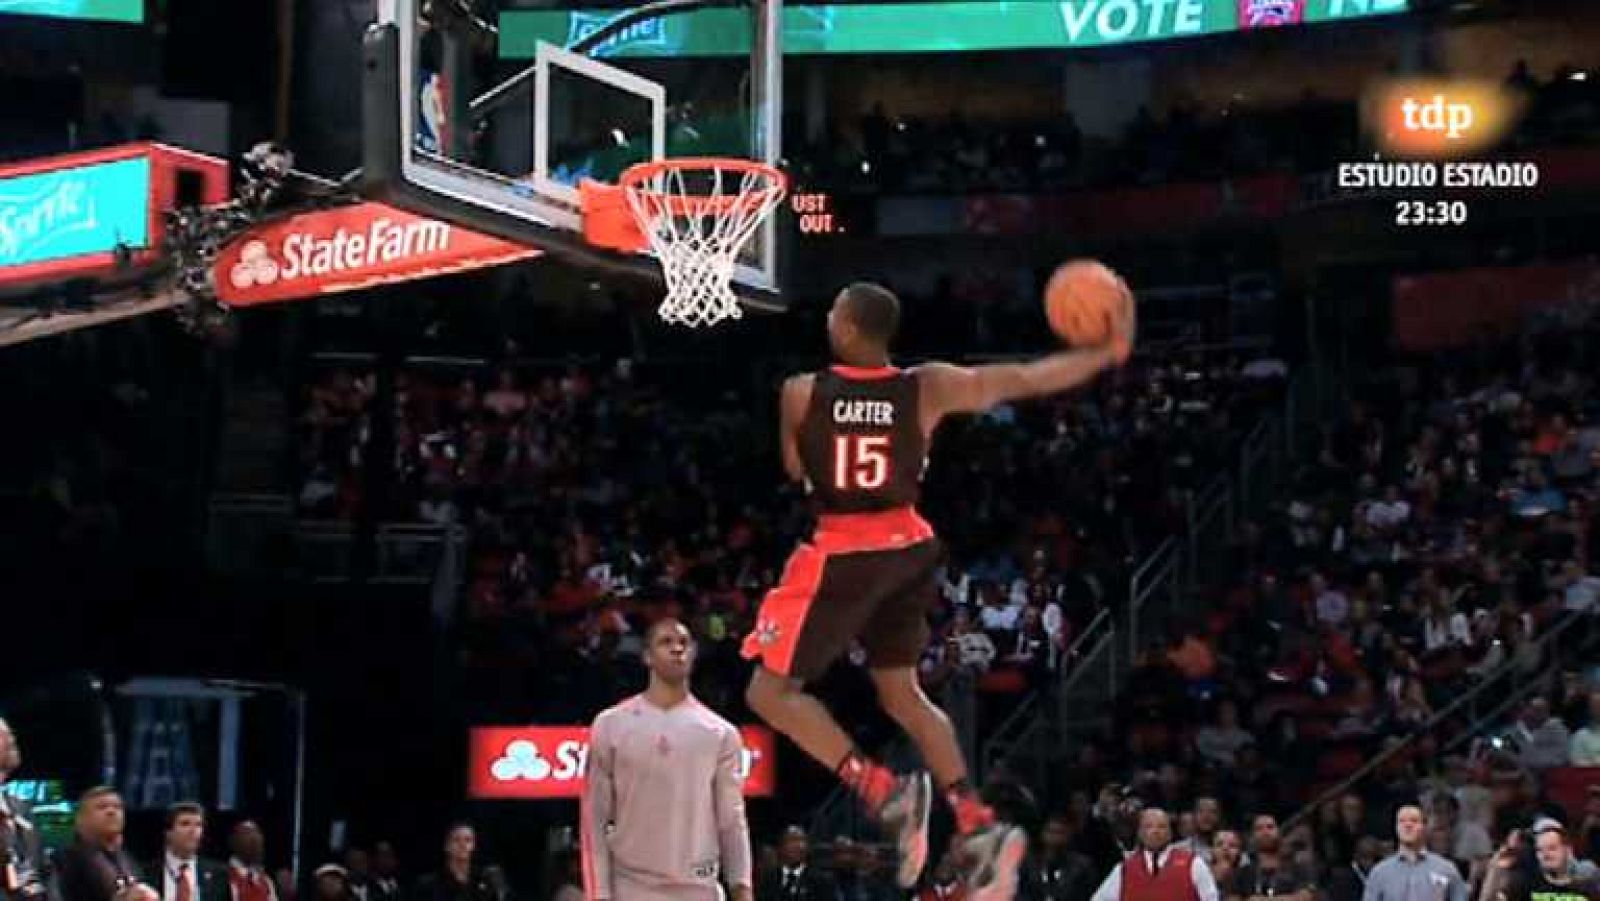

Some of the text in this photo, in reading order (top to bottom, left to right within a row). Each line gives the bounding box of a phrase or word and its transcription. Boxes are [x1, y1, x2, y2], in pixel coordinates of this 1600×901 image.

[1060, 0, 1202, 42] VOTE
[833, 399, 895, 426] CARTER
[833, 434, 890, 490] 15
